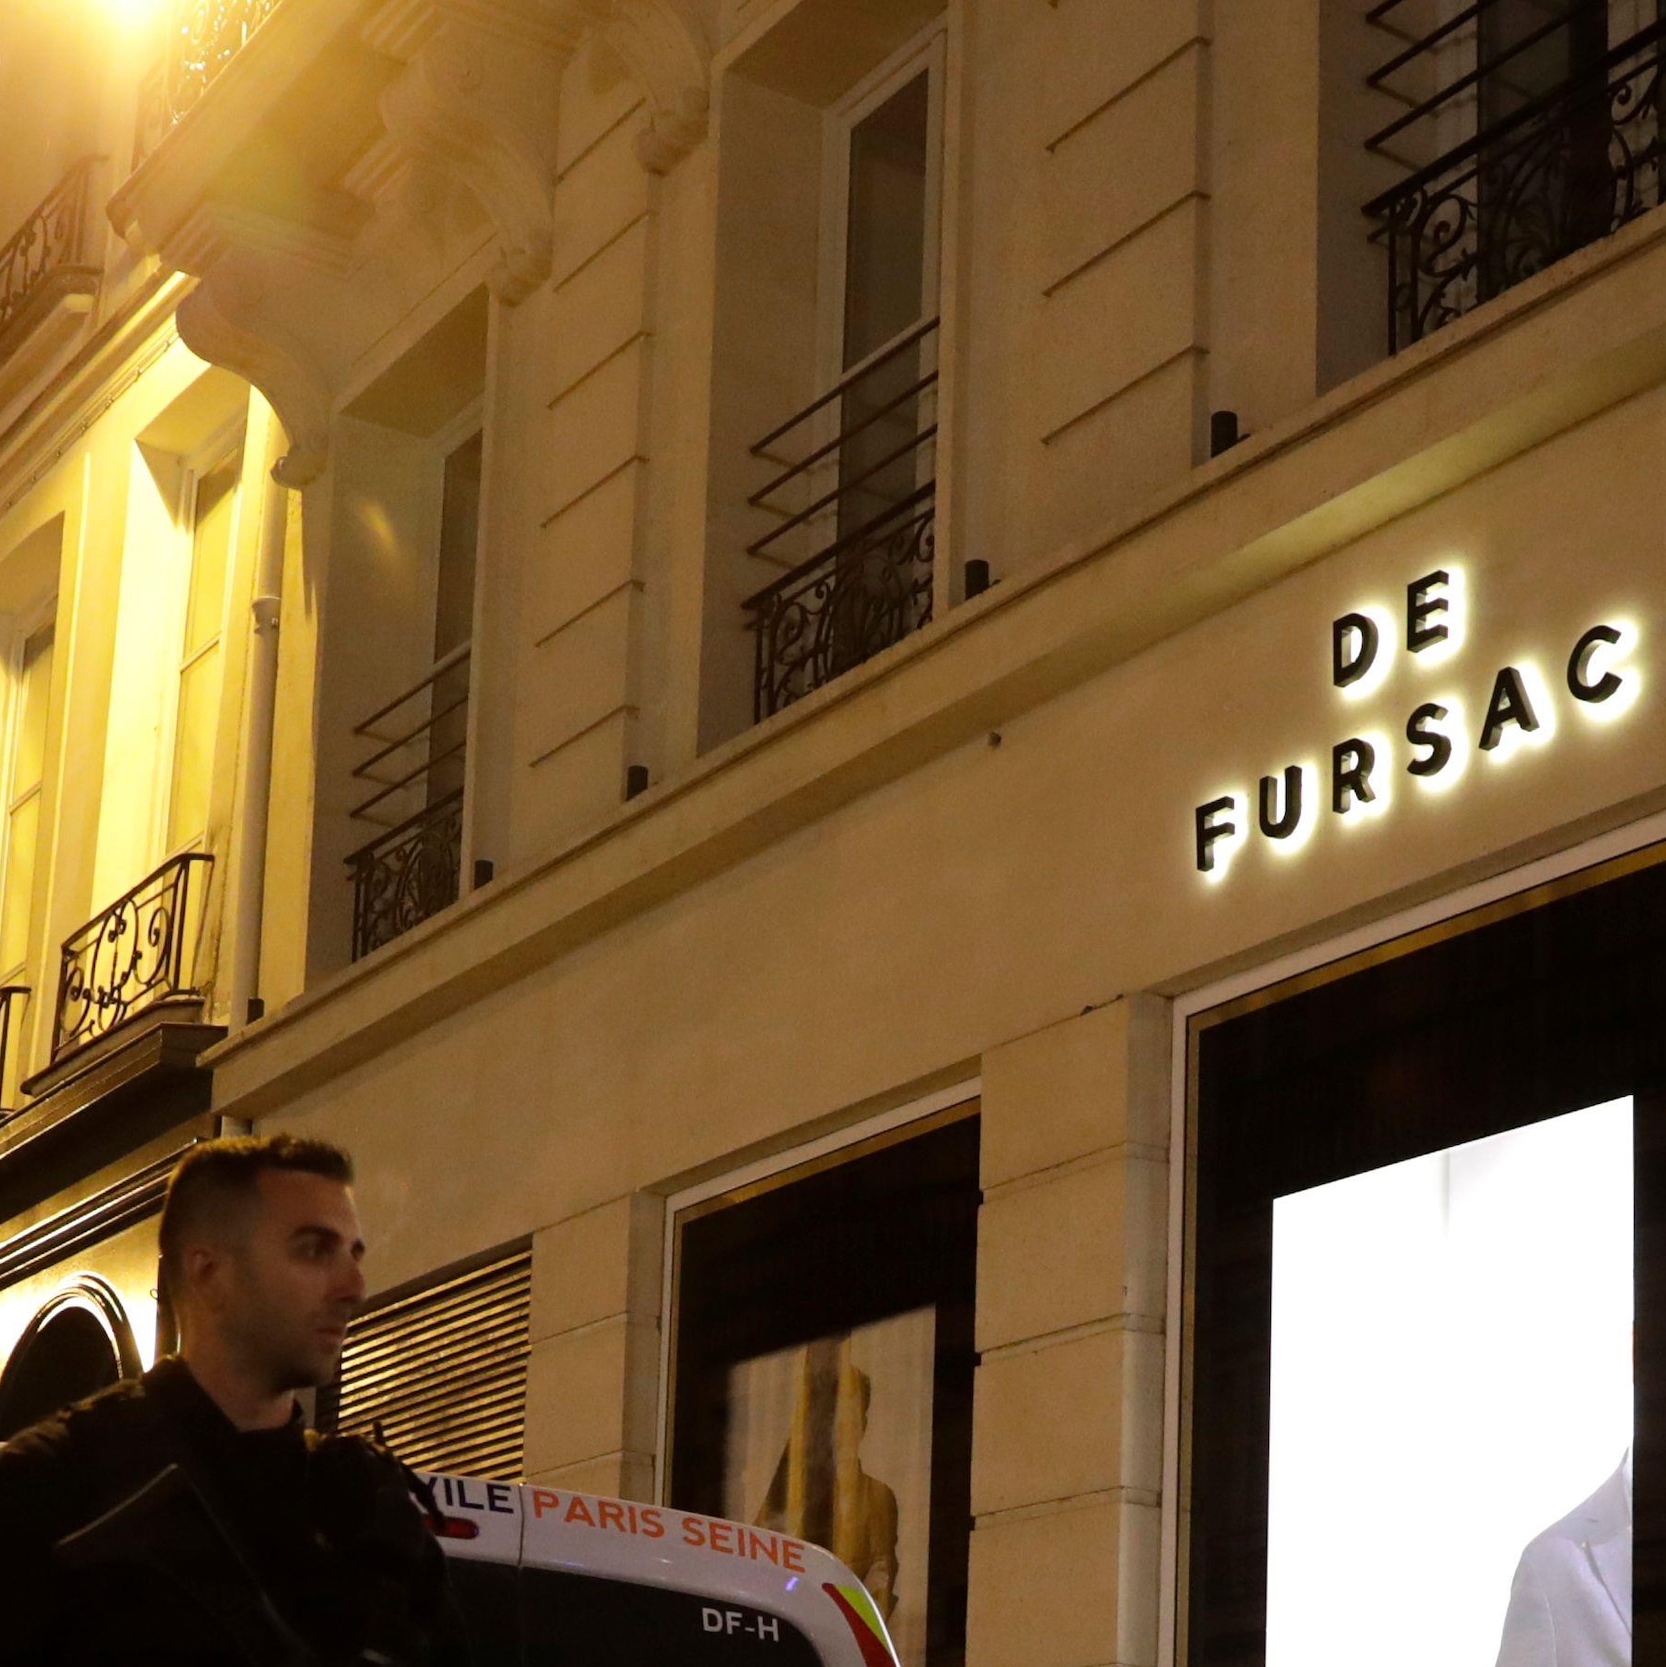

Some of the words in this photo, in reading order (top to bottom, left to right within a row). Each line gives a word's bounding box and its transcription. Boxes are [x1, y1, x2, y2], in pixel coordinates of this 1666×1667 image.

[1332, 570, 1449, 688] DE
[1195, 625, 1623, 872] FURSAC
[533, 1490, 665, 1538] PARIS
[682, 1517, 806, 1573] SEINE
[702, 1607, 779, 1642] DF-H
